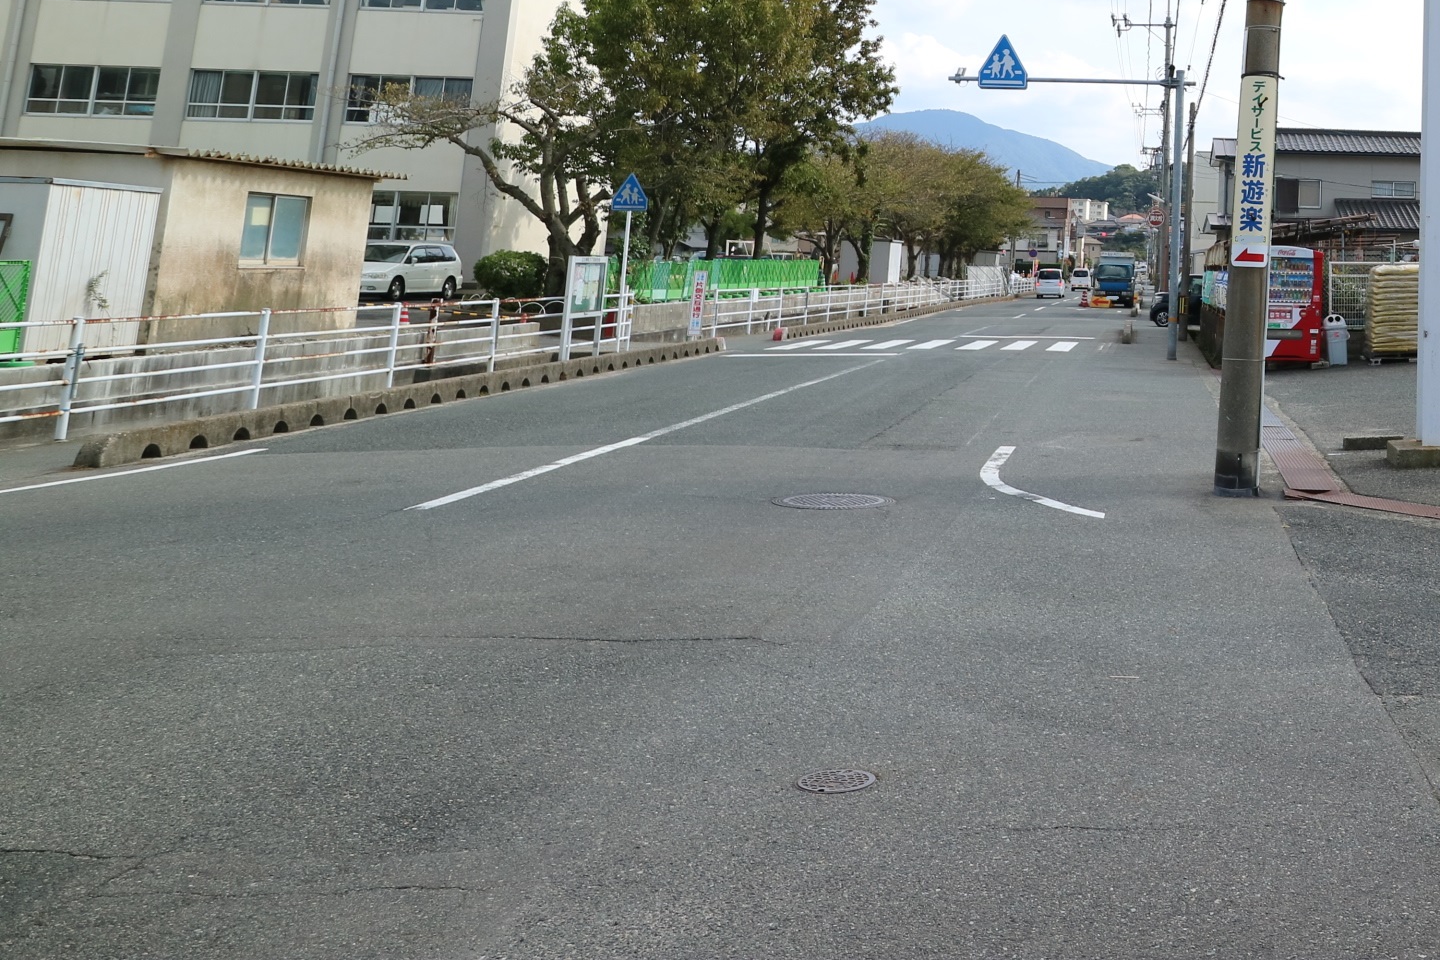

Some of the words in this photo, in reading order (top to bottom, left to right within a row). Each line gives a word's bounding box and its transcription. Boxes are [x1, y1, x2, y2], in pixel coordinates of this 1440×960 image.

[1249, 81, 1267, 153] デイサービス
[1239, 153, 1266, 232] 新遊楽
